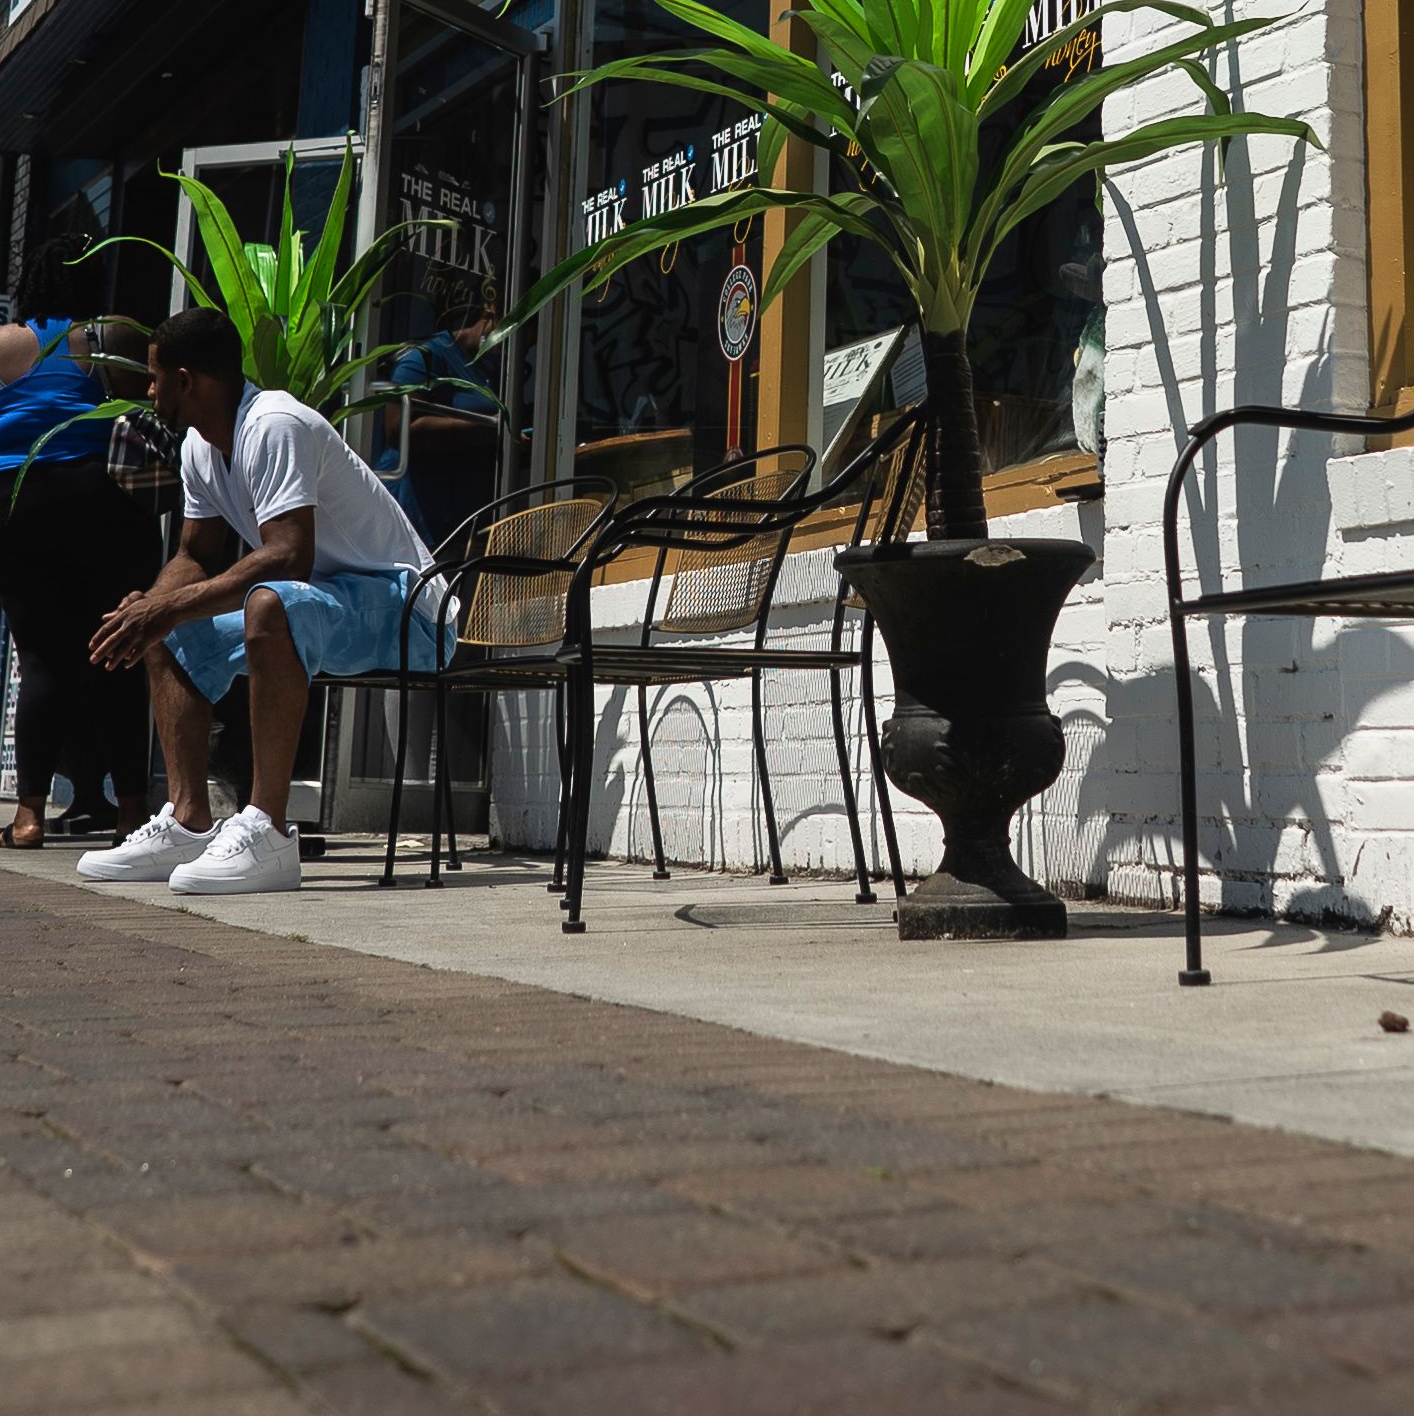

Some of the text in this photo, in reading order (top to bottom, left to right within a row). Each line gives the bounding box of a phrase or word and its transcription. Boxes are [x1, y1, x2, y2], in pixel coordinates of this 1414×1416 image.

[711, 113, 762, 150] THE REAL
[642, 150, 687, 183] THE REAL
[401, 172, 482, 220] THE REAL
[596, 186, 619, 207] REAL
[641, 162, 696, 221] MILK
[399, 197, 498, 281] MILK
[722, 269, 742, 304] COLLEGE
